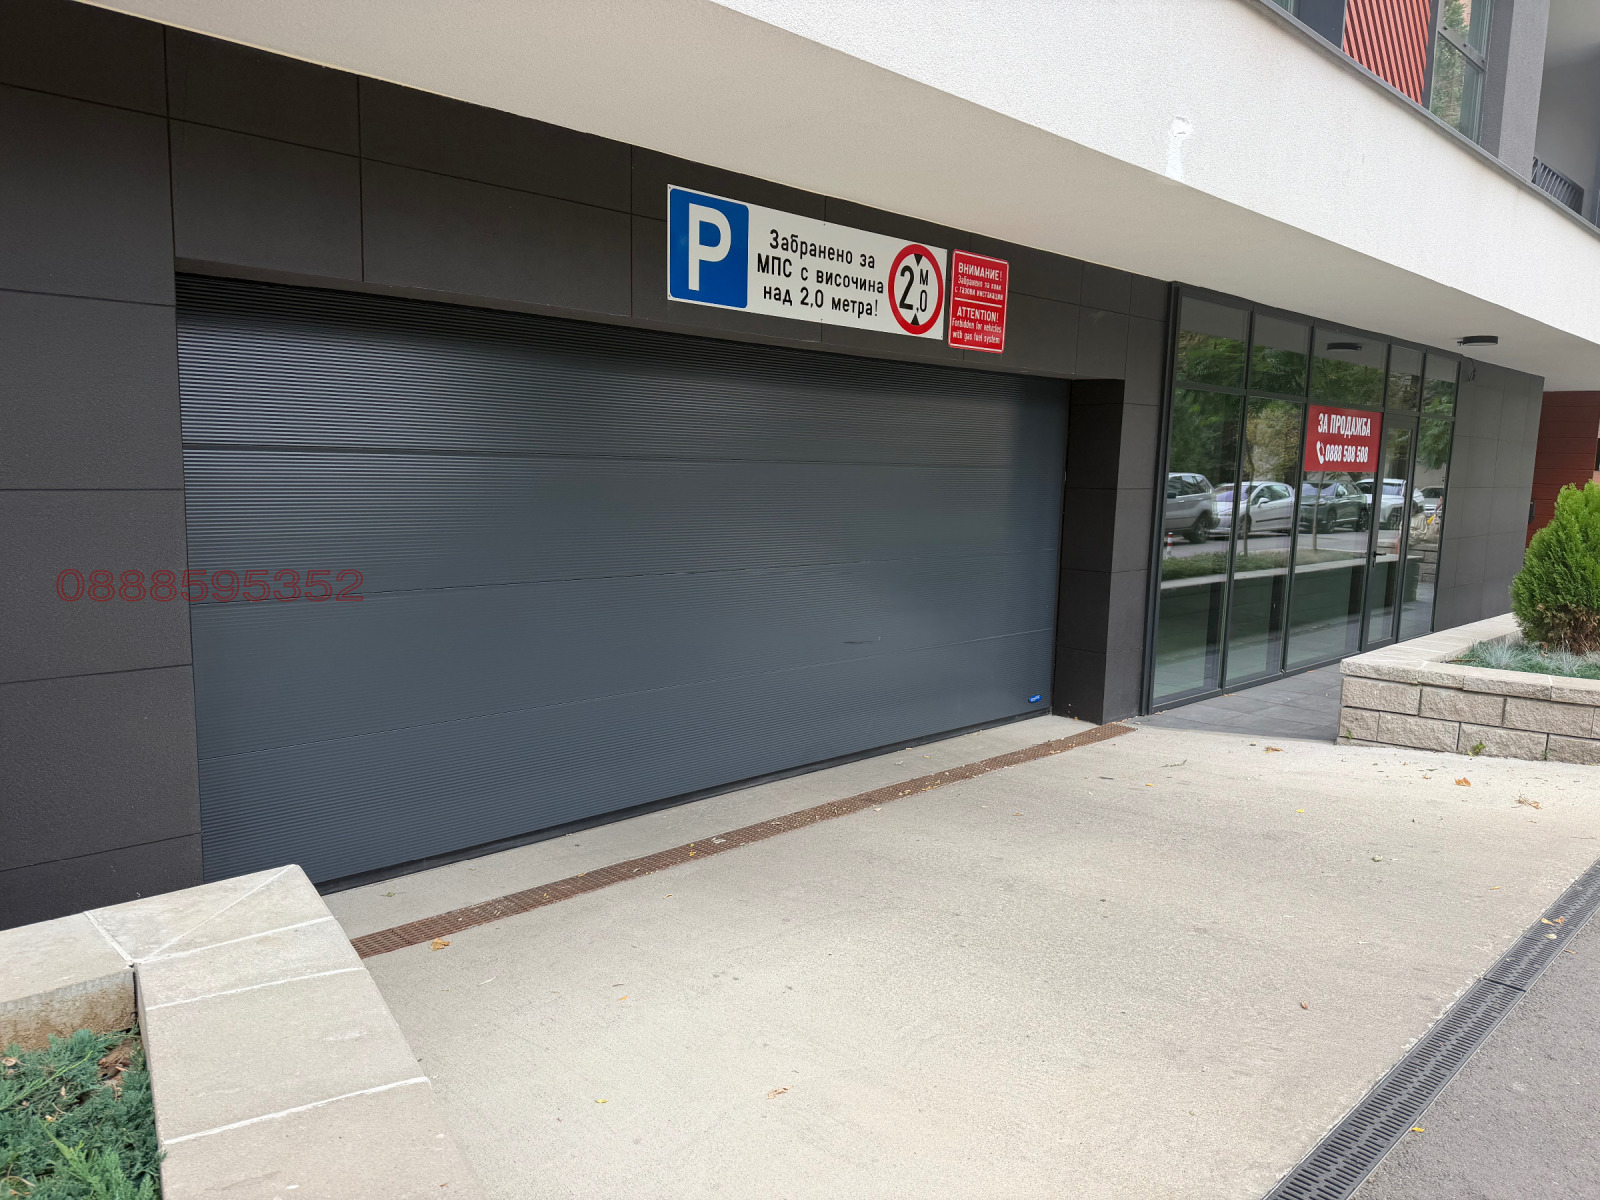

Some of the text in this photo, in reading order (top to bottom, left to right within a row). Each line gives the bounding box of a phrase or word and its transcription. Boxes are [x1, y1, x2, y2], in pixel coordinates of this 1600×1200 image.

[688, 202, 732, 291] P
[769, 228, 875, 269] Забранено за
[757, 252, 884, 294] МПС с височина
[958, 262, 1002, 281] ВНИМАНИЕ!
[958, 275, 982, 287] Забранено
[763, 285, 878, 318] над 2,0 метра!
[957, 306, 998, 322] ATTENTION!
[952, 318, 974, 329] Forbidden
[984, 324, 1001, 333] vehicles
[952, 330, 1000, 344] with gas fuel system
[1318, 413, 1371, 439] ЗА ПРОДАЖБА
[1325, 443, 1369, 463] 0888 508 508
